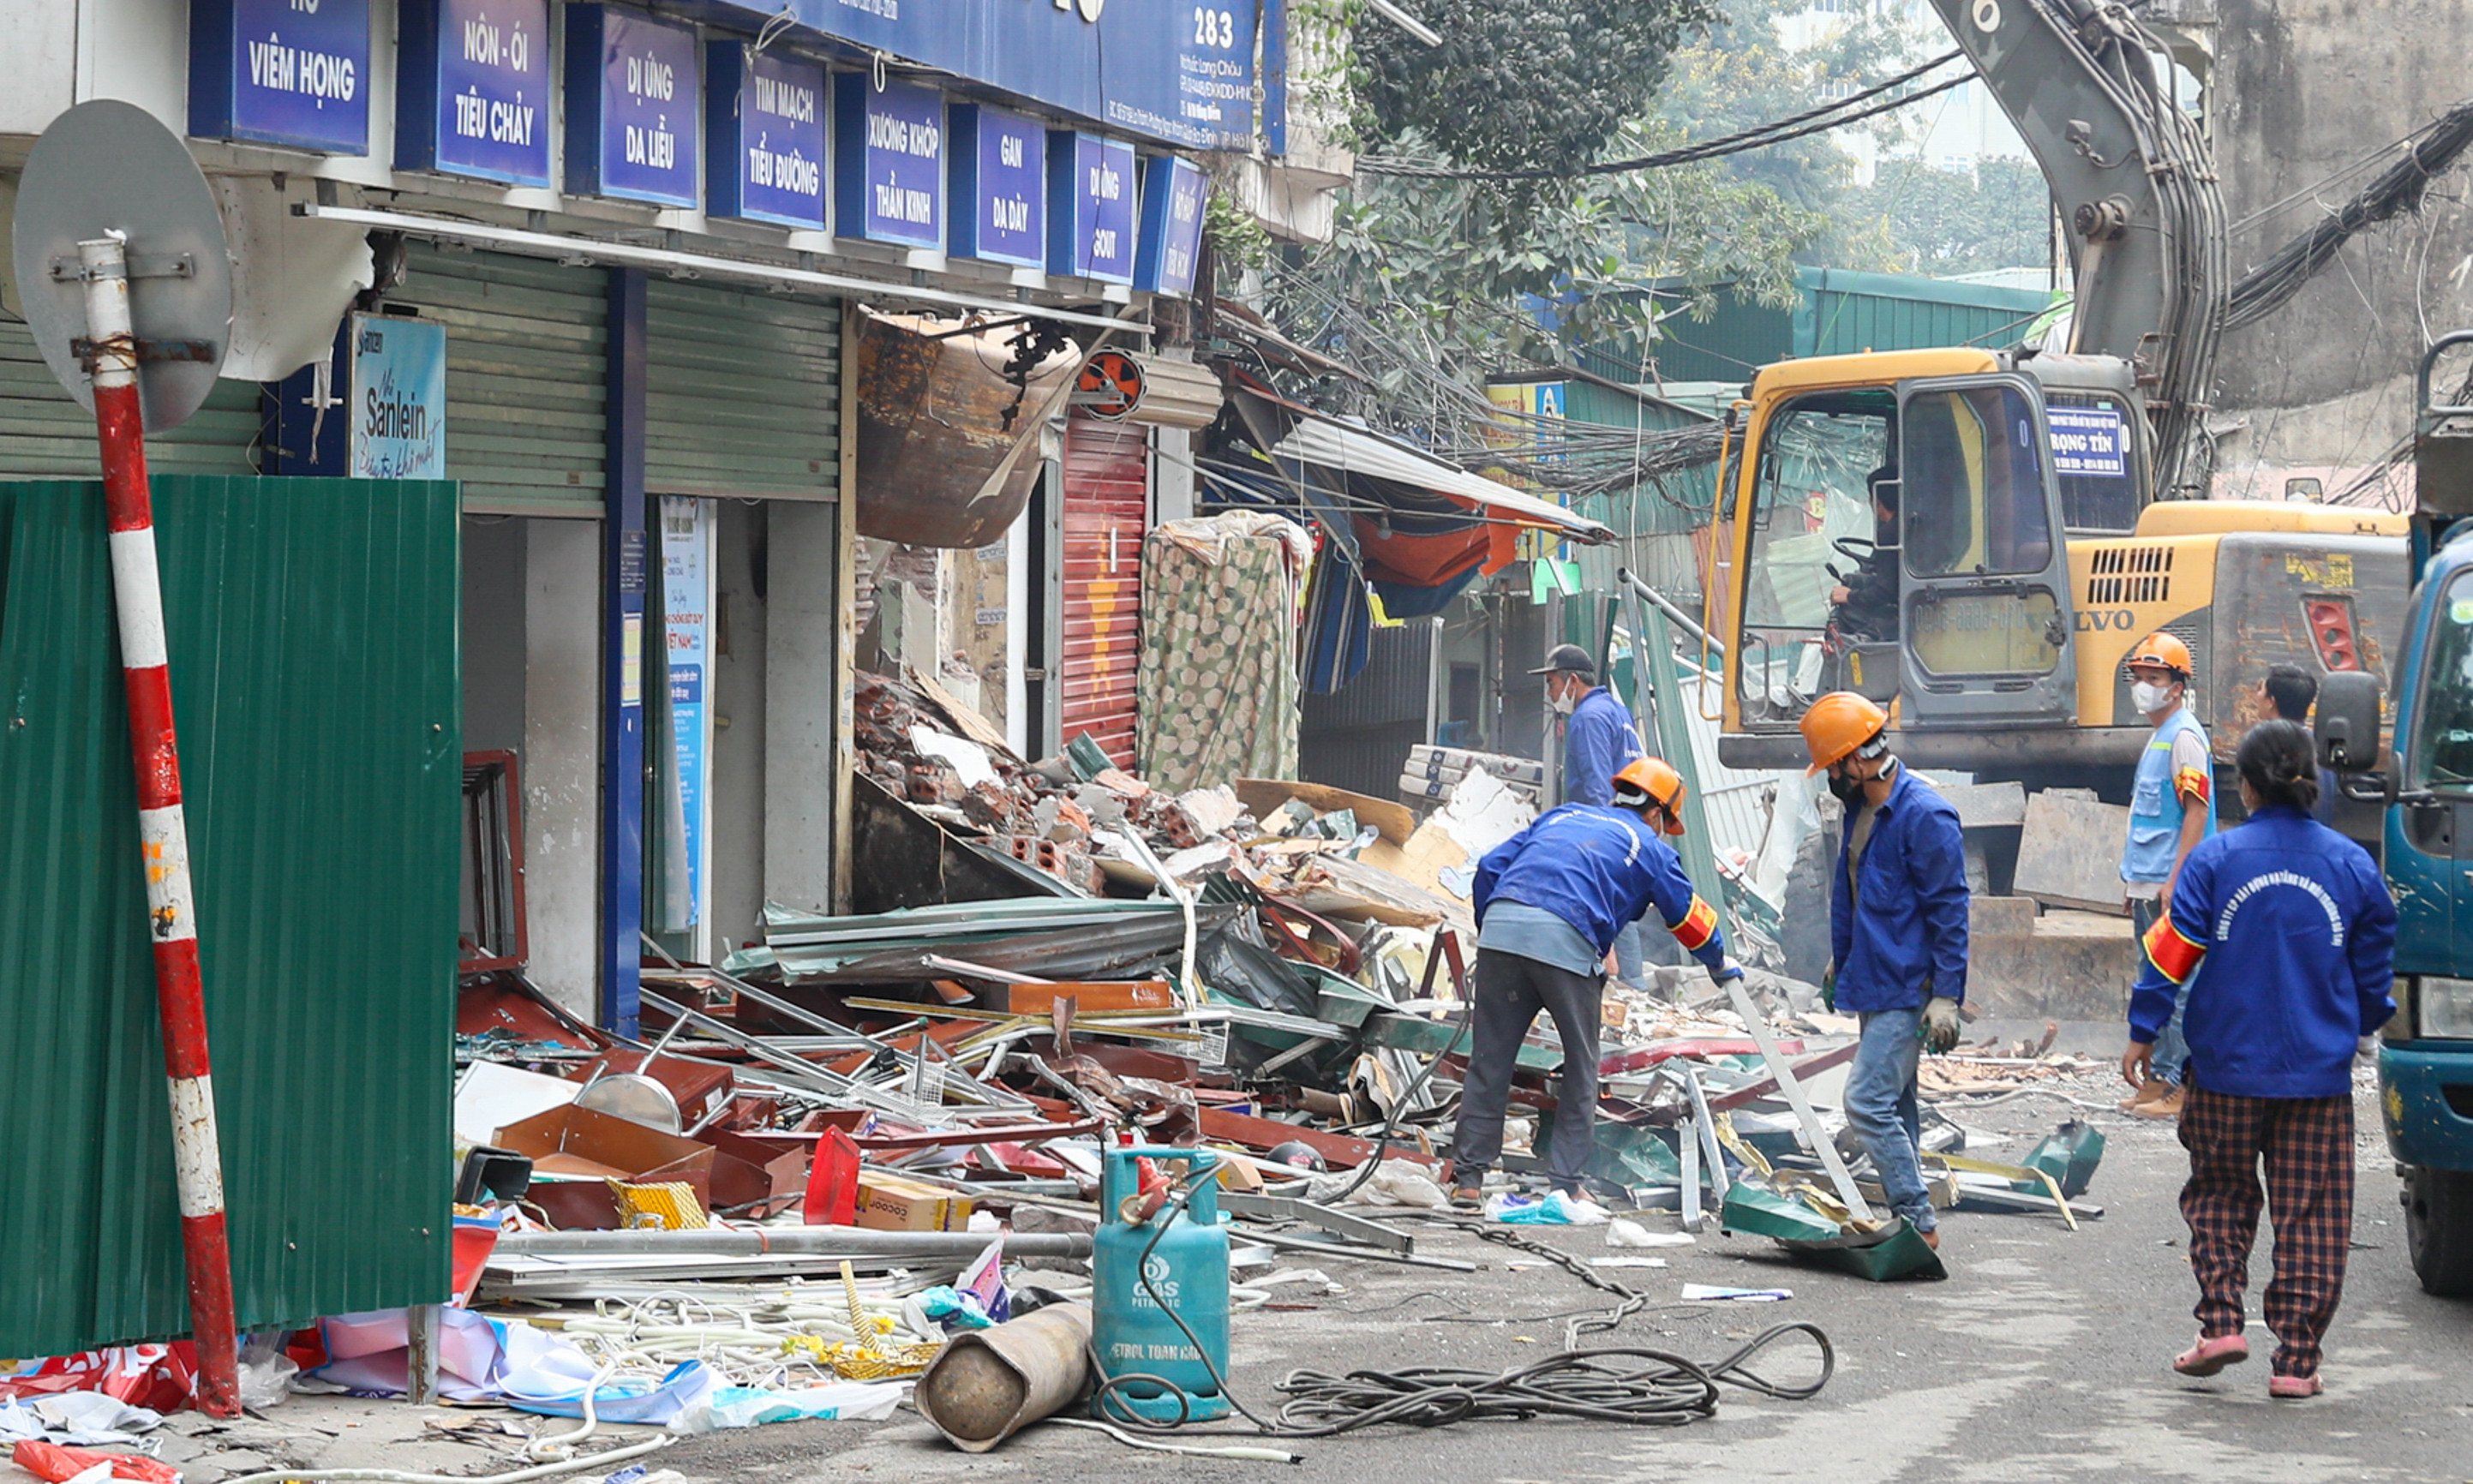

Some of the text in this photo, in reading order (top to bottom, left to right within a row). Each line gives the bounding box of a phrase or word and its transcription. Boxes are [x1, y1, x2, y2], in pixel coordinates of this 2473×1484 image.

[464, 12, 499, 66] NÔN
[512, 21, 528, 72] ÓI
[1195, 6, 1234, 49] 283
[248, 32, 355, 110] VIÊM HỌNG
[627, 51, 674, 106] DỊ ỨNG
[456, 85, 534, 147] TIÊU CHẢY
[755, 75, 814, 129] TIM MẠCH
[626, 114, 674, 170] DA LIỄU
[869, 112, 939, 159] XƯƠNG KHỚP
[1001, 135, 1022, 169] GAN
[749, 131, 819, 196] TIỂU ĐƯỜNG
[906, 189, 931, 224] KINH
[993, 192, 1028, 237] DẠ DÀY
[366, 386, 426, 440] Sanlein
[2050, 431, 2113, 455] RỌNG TÍN
[1133, 1280, 1180, 1297] GAS
